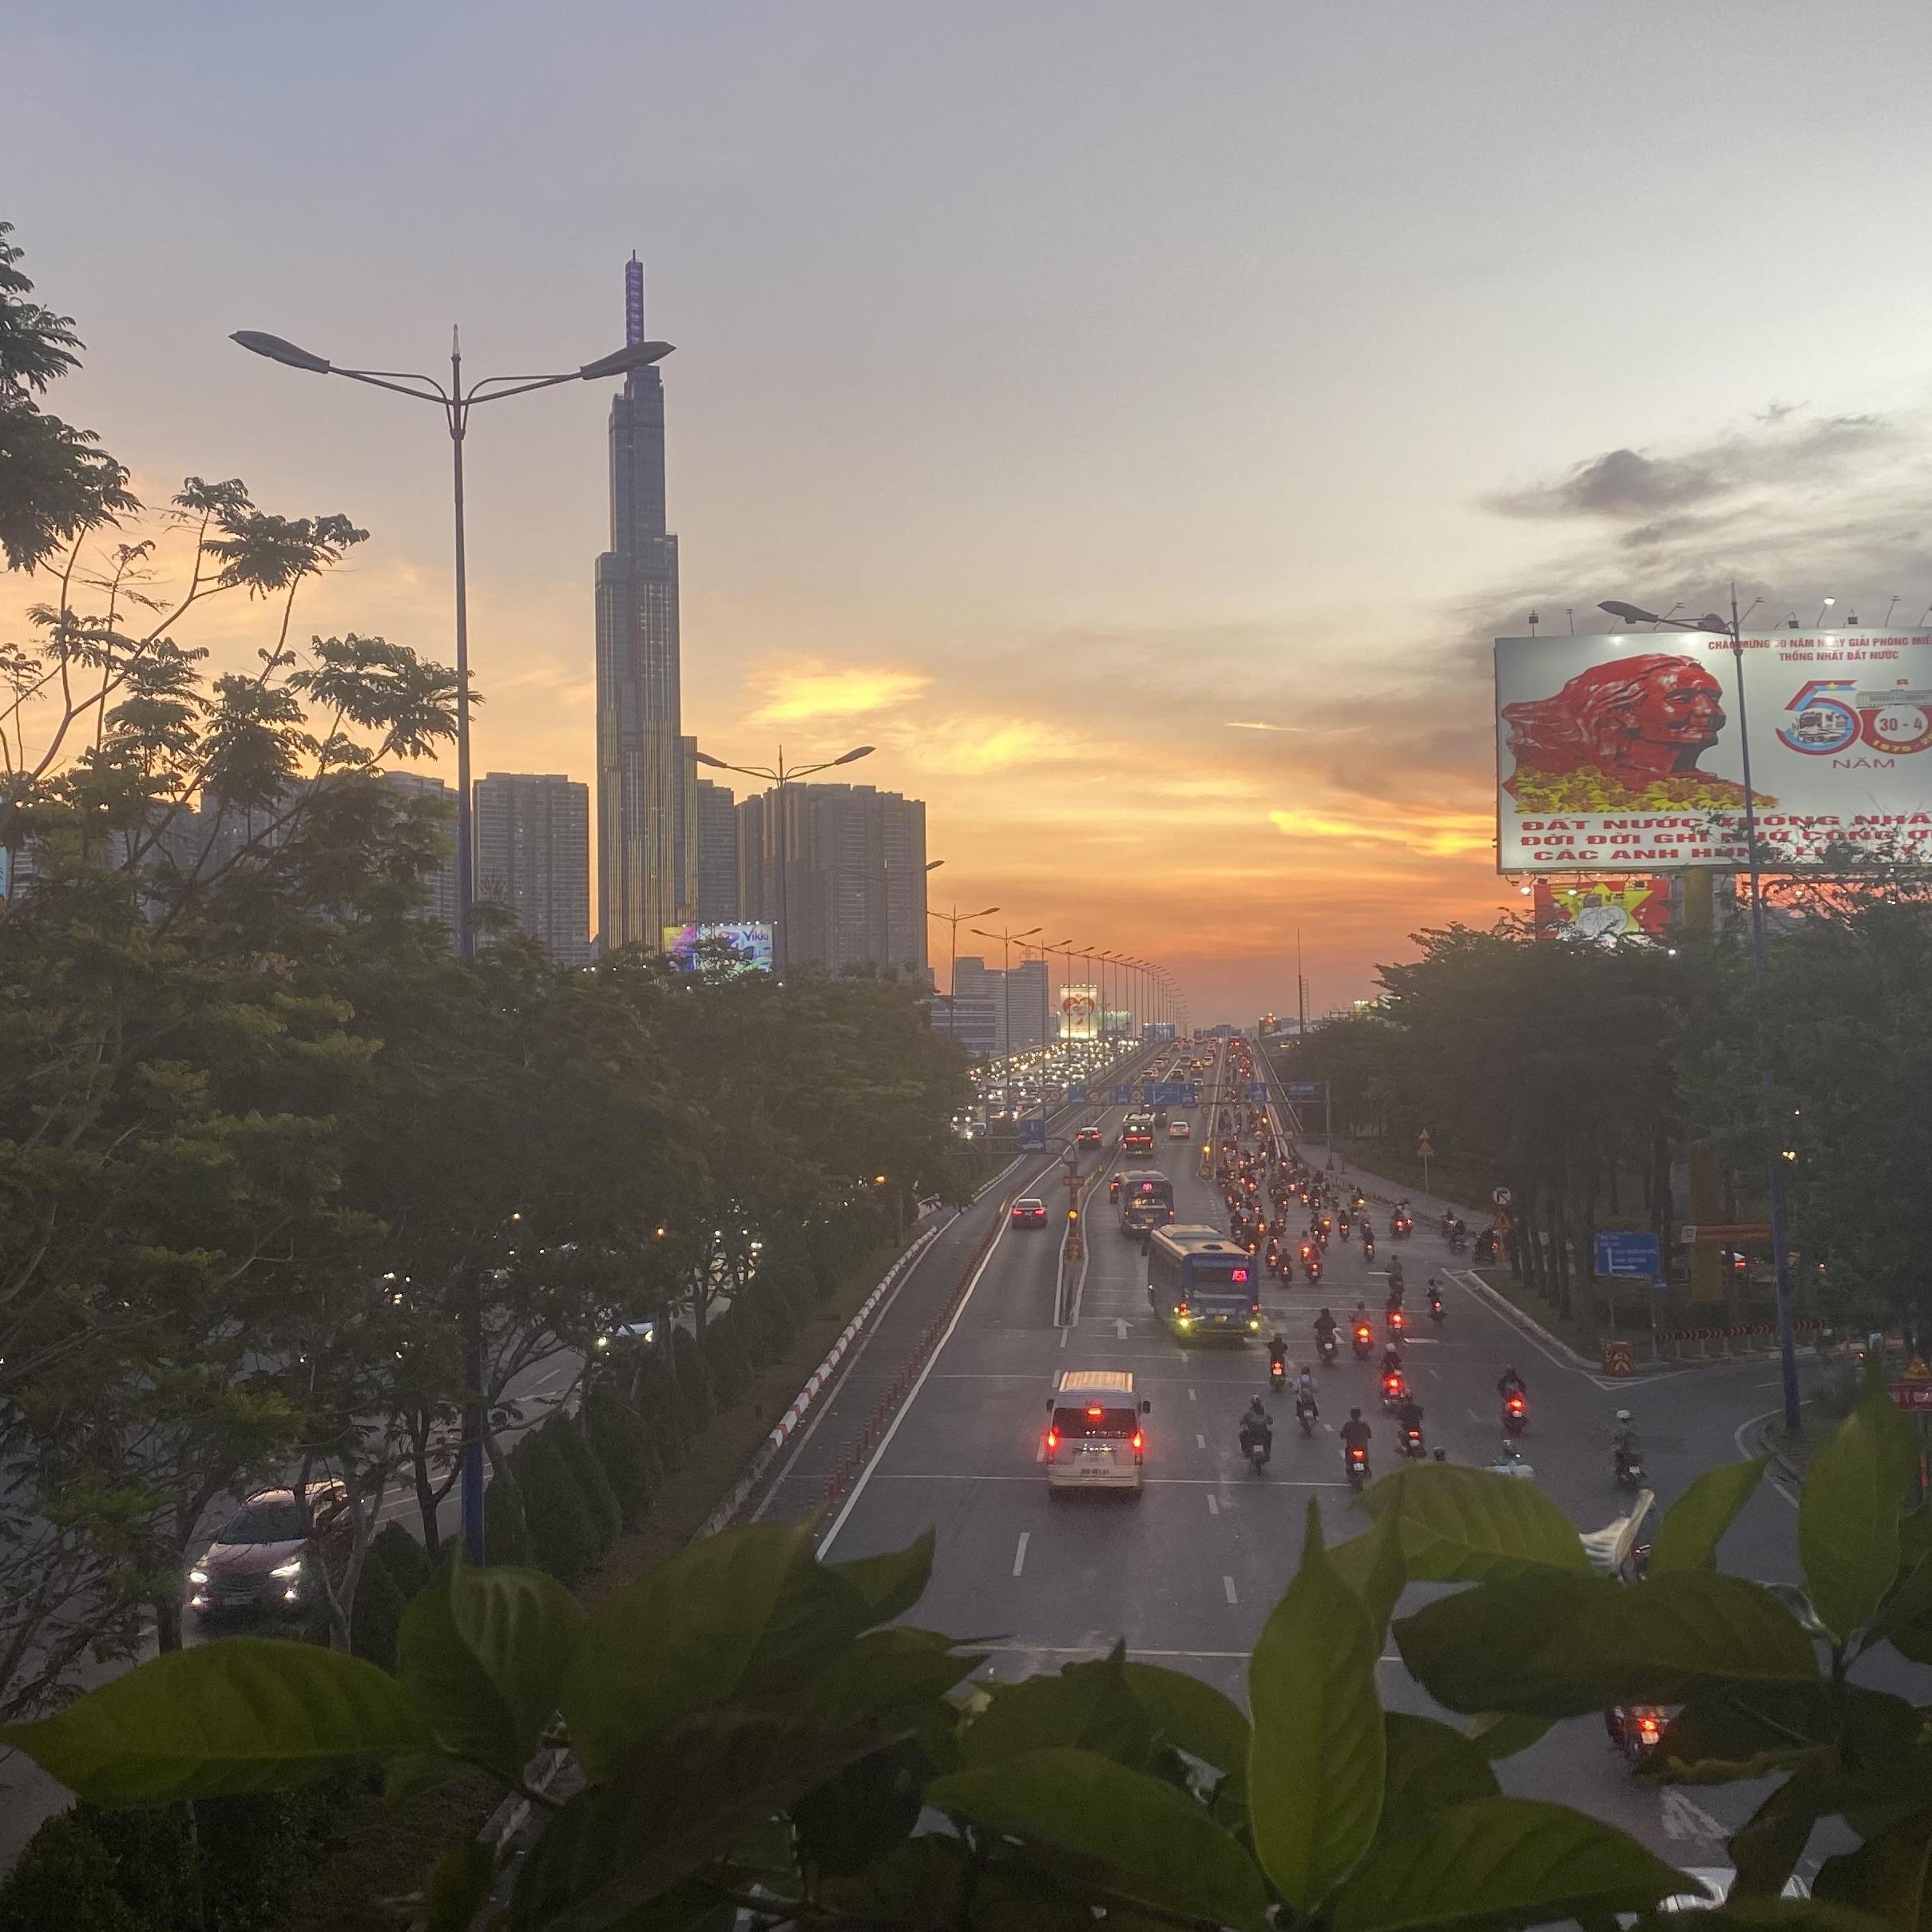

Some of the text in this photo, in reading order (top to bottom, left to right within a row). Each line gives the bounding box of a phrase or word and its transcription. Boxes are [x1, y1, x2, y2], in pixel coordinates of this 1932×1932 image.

[1879, 717, 1898, 732] 30
[1914, 717, 1923, 731] 4
[1832, 757, 1894, 769] NĂM
[1521, 817, 1589, 831] ĐẤT
[1603, 815, 1704, 830] NƯỚC
[1521, 833, 1574, 847] ĐỜI
[1585, 832, 1641, 845] ĐỜI
[1654, 832, 1708, 843] GHI
[1533, 848, 1599, 862] CÁC
[1610, 848, 1679, 860] ANH
